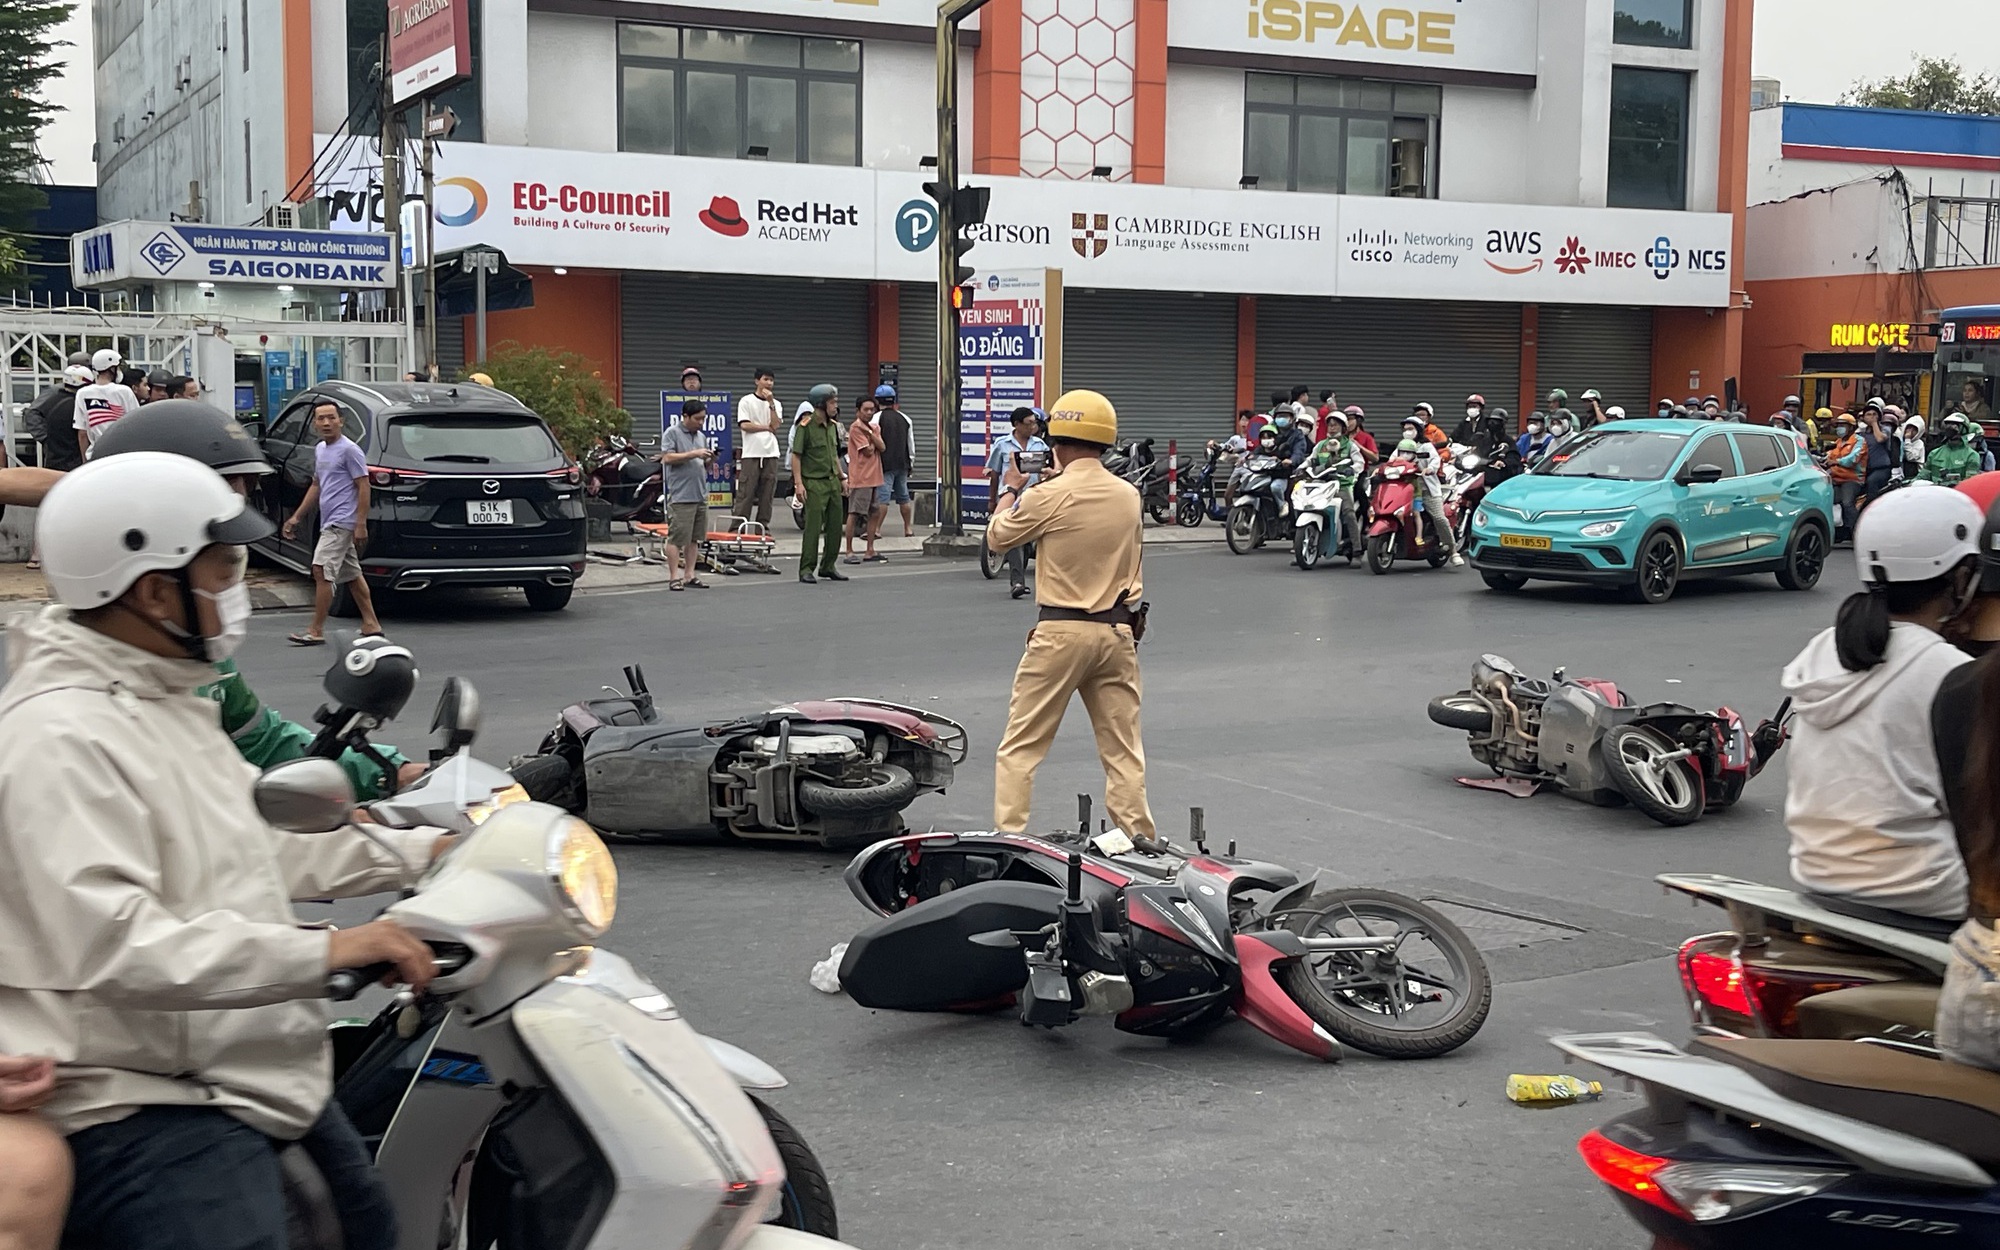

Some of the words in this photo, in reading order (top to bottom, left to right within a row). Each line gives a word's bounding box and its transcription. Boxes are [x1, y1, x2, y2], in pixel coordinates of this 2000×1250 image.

[1248, 0, 1456, 55] iSPACE
[513, 182, 671, 218] EC-Council
[757, 199, 808, 223] Red
[813, 202, 858, 226] Hat
[513, 216, 558, 230] Building
[562, 219, 570, 228] A
[573, 219, 611, 231] Culture
[614, 221, 627, 231] Of
[629, 222, 671, 236] Security
[758, 225, 831, 242] ACADEMY
[963, 222, 1051, 244] earson
[1114, 215, 1233, 238] CAMBRIDGE
[1239, 222, 1321, 242] ENGLISH
[193, 234, 221, 249] NGÂN
[223, 236, 250, 250] HÀNG
[251, 239, 279, 251] TMCP
[280, 238, 296, 252] SÀI
[299, 239, 319, 253] GÒN
[320, 240, 346, 255] CÔNG
[347, 243, 386, 256] THƯƠNG
[1114, 235, 1176, 252] Language
[1180, 237, 1250, 252] Assessment
[1403, 231, 1474, 250] Networking
[1486, 229, 1542, 255] aws
[83, 233, 115, 274] ATM
[1403, 250, 1459, 268] Academy
[1595, 251, 1637, 269] IMEC
[1688, 249, 1726, 270] NCS
[208, 259, 385, 282] SAIGONBANK
[984, 308, 1012, 324] SINH
[960, 336, 977, 357] AO
[979, 327, 1024, 357] ĐẲNG
[1831, 323, 1865, 347] RUM
[1867, 323, 1910, 347] CAFE
[1052, 410, 1085, 422] CSGT
[472, 512, 508, 523] 000.79
[479, 502, 499, 512] 61K
[1827, 1210, 1960, 1235] LEAD
